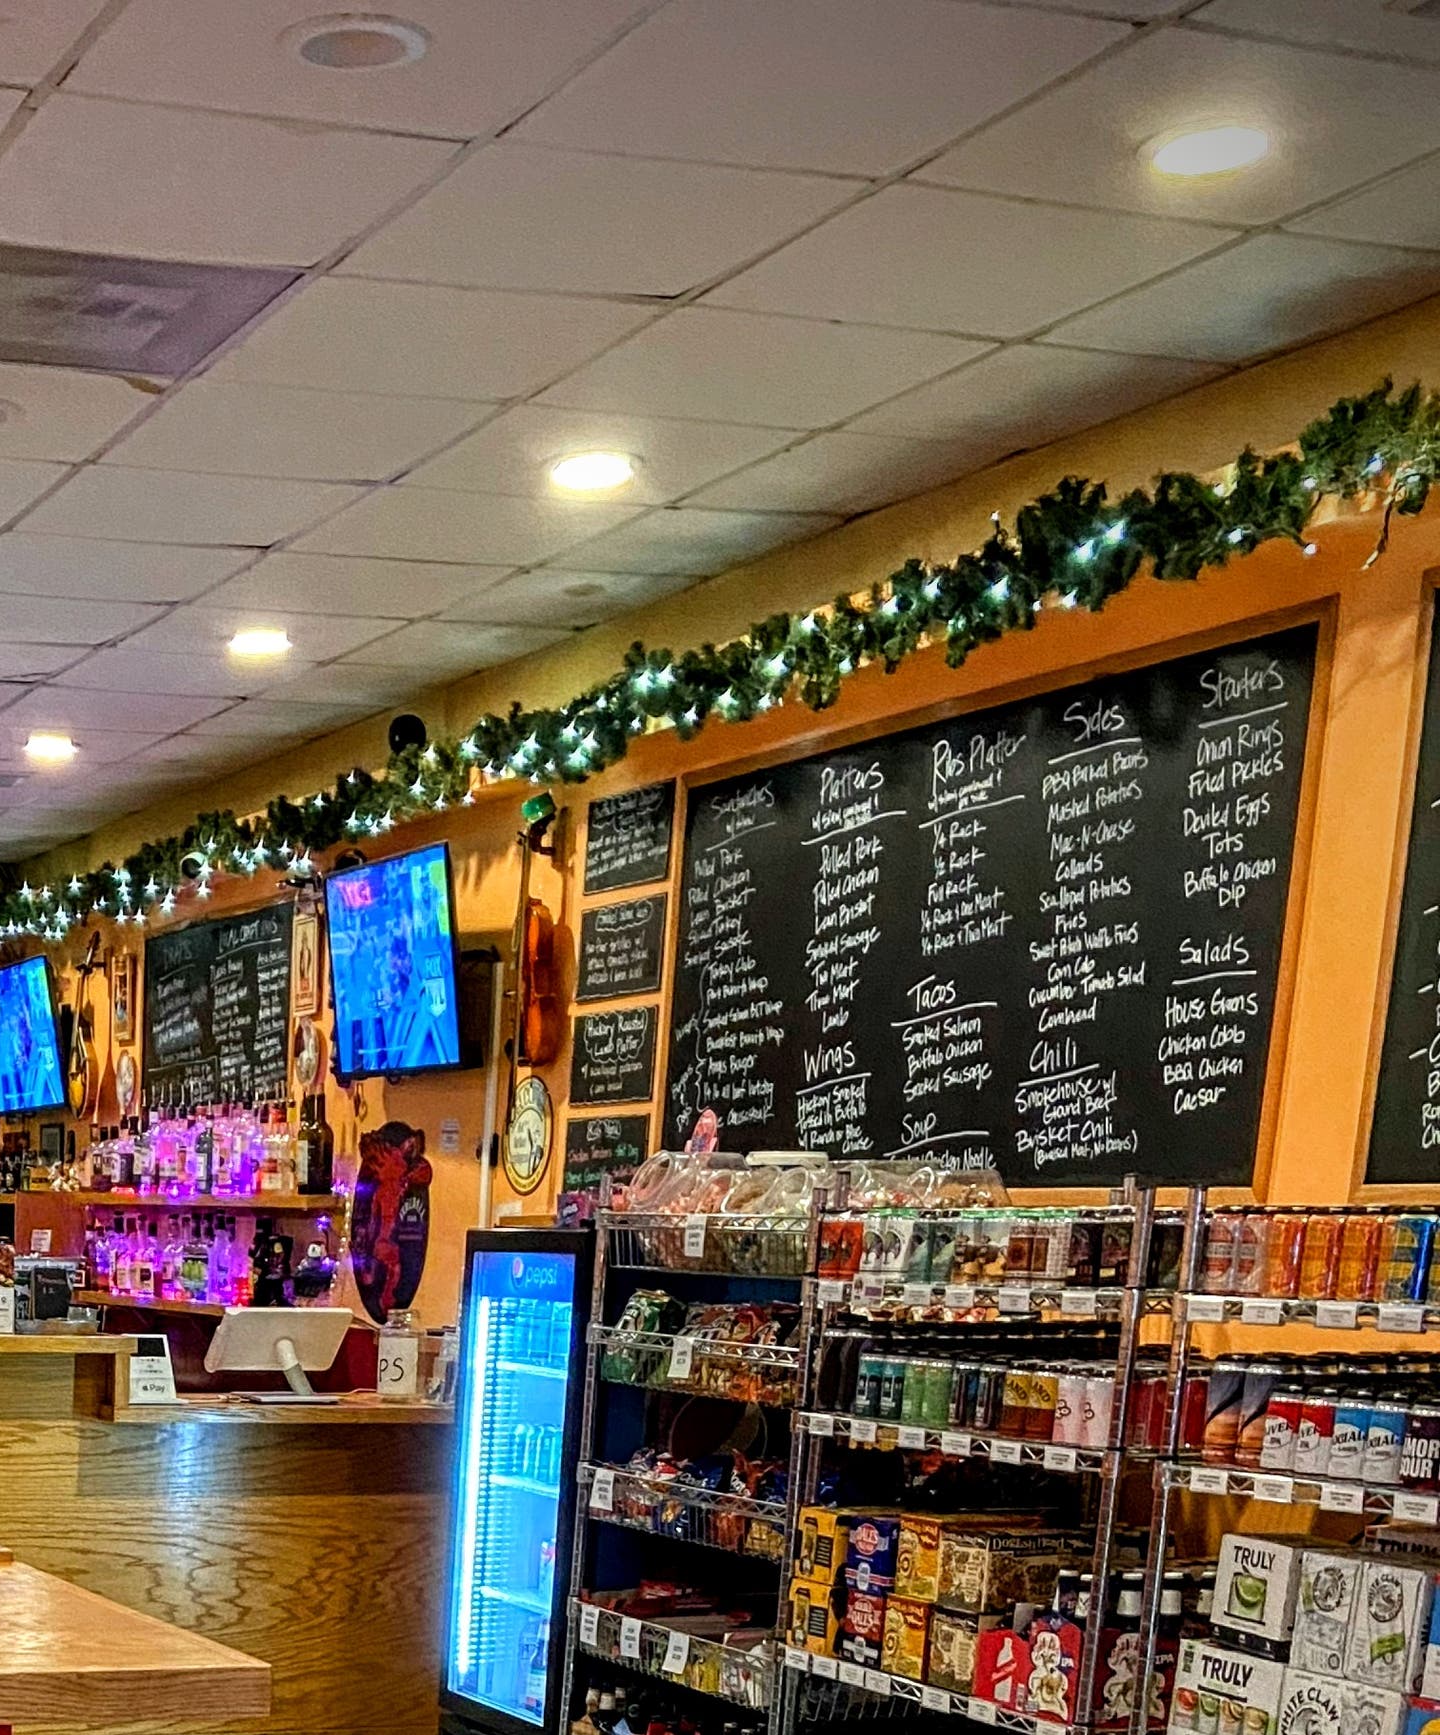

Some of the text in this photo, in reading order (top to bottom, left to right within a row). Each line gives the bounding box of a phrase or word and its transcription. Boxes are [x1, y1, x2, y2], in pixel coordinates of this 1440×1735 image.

[1200, 660, 1283, 708] Starters
[1064, 699, 1125, 742] Sides
[970, 731, 1026, 773] Platter
[1196, 720, 1283, 767] Onion Rings
[821, 762, 885, 805] Platters
[1188, 767, 1224, 799] Fried
[1047, 793, 1089, 832] Mashed
[1236, 792, 1270, 827] Eggs
[949, 819, 987, 846] Rack
[1201, 831, 1243, 859] Tots
[856, 835, 884, 864] Pork
[949, 846, 986, 874] Rack
[928, 873, 979, 906] Full Rack
[1184, 863, 1229, 898] Buffalo
[1055, 911, 1087, 935] Fries
[1179, 934, 1249, 965] Salads
[831, 956, 859, 984] Meat
[1048, 962, 1071, 982] Corn
[1117, 960, 1145, 987] Salad
[833, 979, 859, 1003] Meat
[907, 975, 956, 1013] Tacos
[944, 1017, 981, 1038] Salmon
[1159, 1024, 1245, 1061] Chicken Cobb
[804, 1041, 855, 1082] Wings
[908, 1049, 944, 1078] Buffalo
[1029, 1036, 1076, 1074] Chili
[943, 1062, 993, 1091] Sausage
[1164, 1056, 1243, 1085] BBQ Chicken
[833, 1077, 866, 1099] Smoked
[1015, 1077, 1100, 1113] Smokehouse
[1085, 1090, 1117, 1115] Beef
[1174, 1087, 1226, 1114] Caesar
[901, 1112, 937, 1146] Soup
[1015, 1117, 1112, 1152] Brisket Chili
[962, 1146, 997, 1171] Noodle
[525, 1264, 558, 1288] pepsi
[1234, 1545, 1275, 1571] TRULY
[1155, 1653, 1174, 1665] IPA
[1201, 1654, 1253, 1688] TRULY
[1307, 1686, 1338, 1722] CLAW
